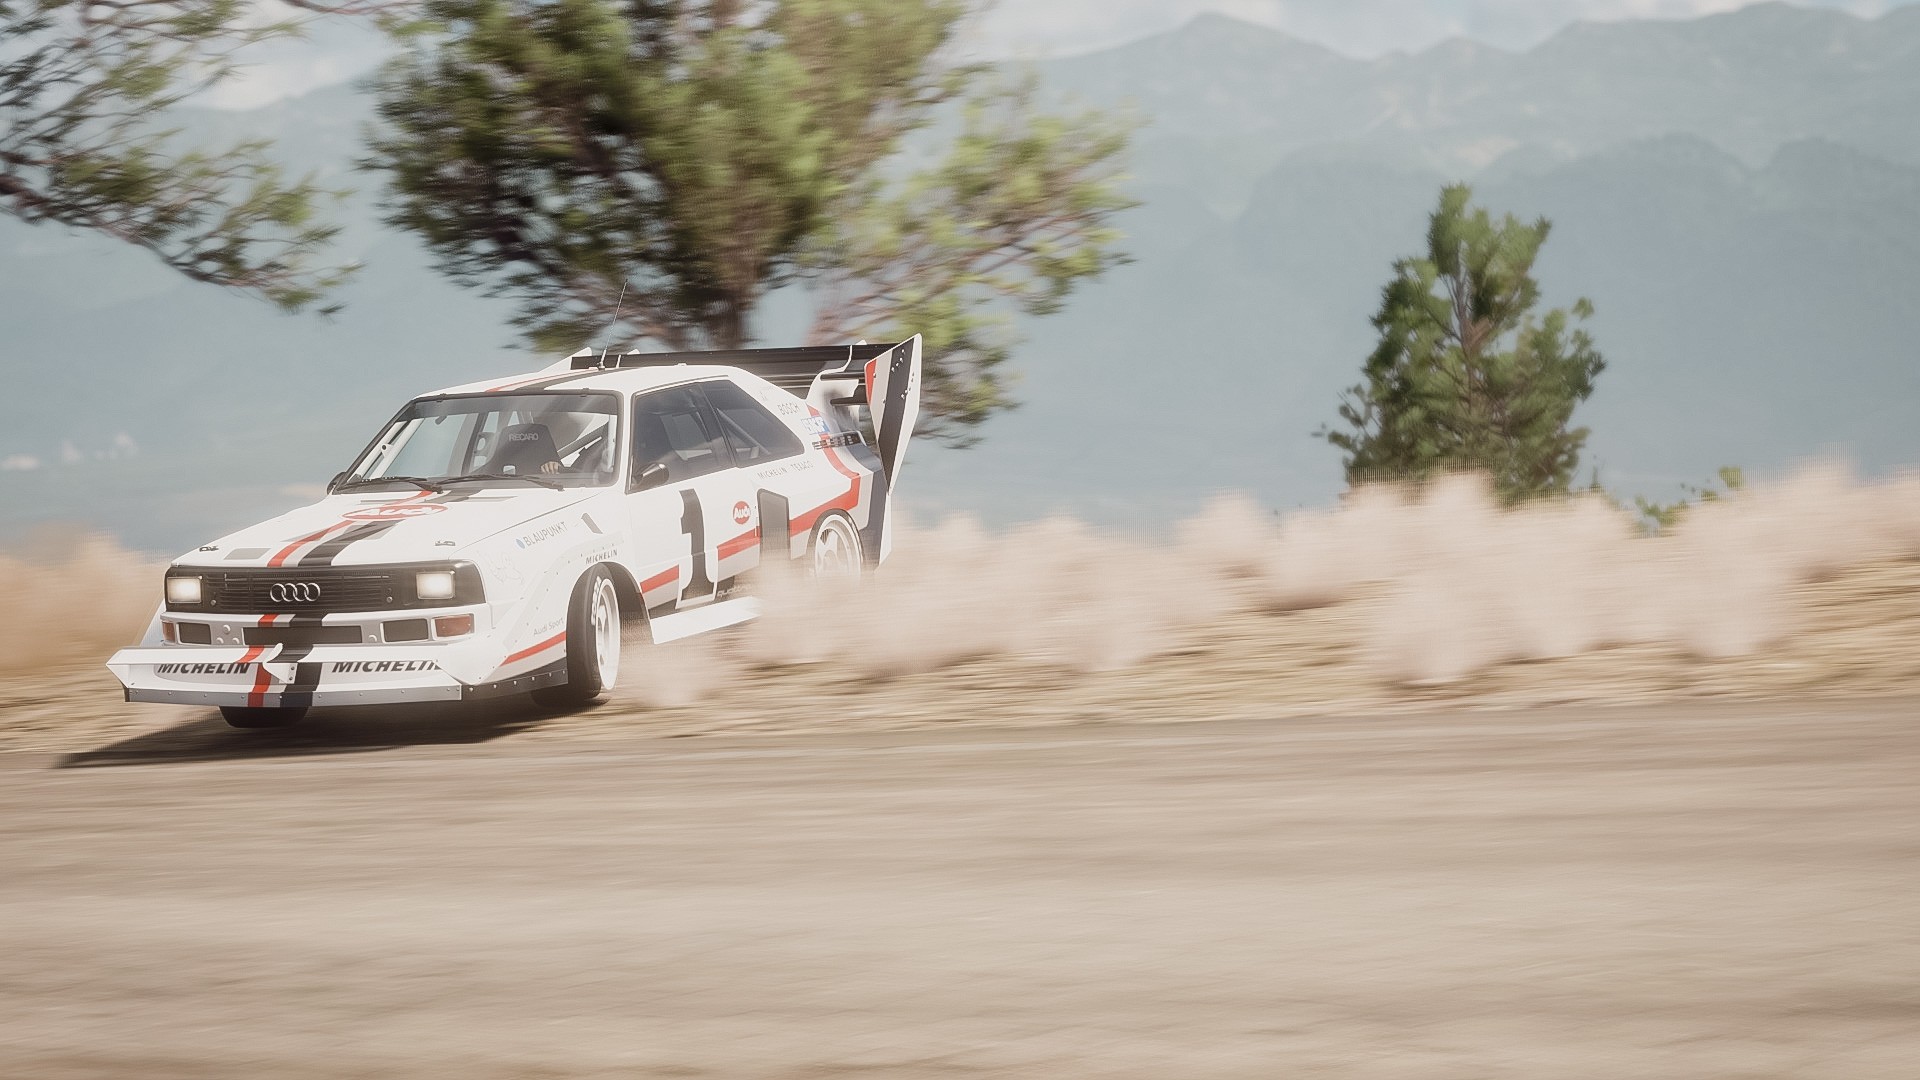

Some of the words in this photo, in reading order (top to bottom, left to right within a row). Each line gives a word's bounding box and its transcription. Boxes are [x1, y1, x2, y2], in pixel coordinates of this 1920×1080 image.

[509, 432, 539, 441] RECARO
[757, 466, 788, 481] MICHELIN
[733, 505, 750, 520] Audi
[523, 521, 567, 547] BLAUPUNKT
[679, 488, 715, 601] 1
[585, 549, 618, 565] MICHELIN
[533, 624, 548, 637] Audi
[158, 663, 251, 674] MICHELIN
